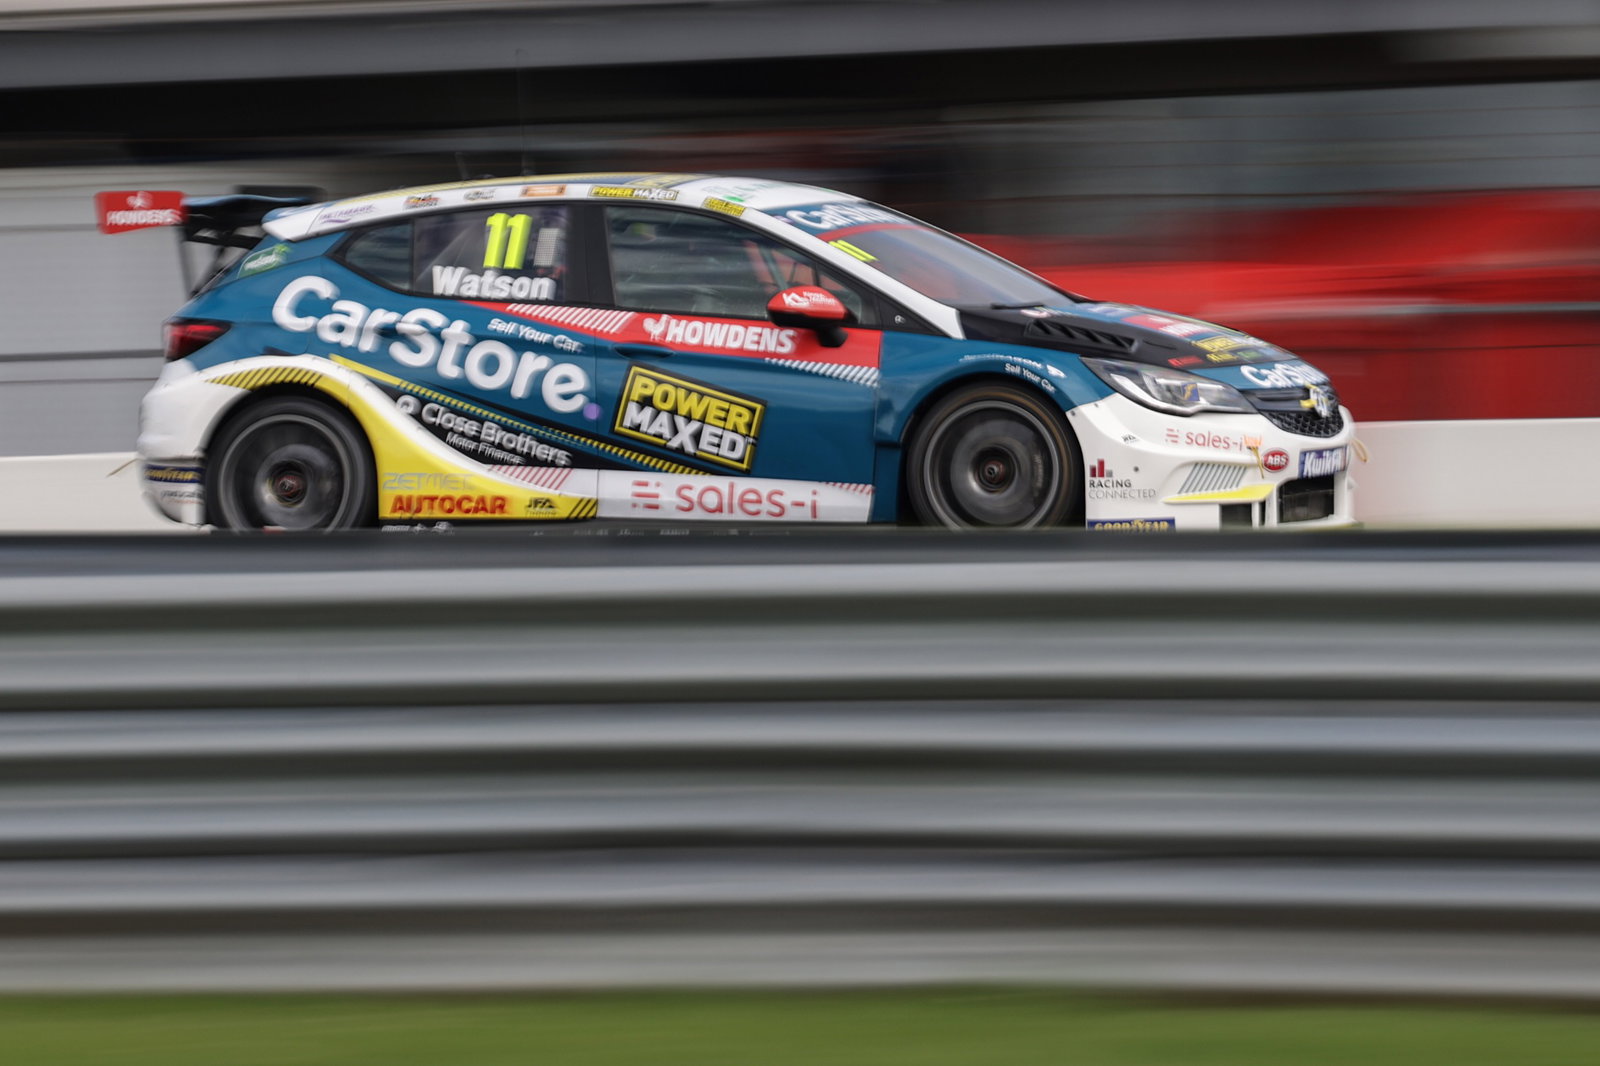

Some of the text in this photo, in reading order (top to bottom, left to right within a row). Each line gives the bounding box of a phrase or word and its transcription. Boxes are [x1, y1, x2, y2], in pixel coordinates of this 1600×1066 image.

[592, 187, 676, 200] POWER MAXED
[482, 213, 533, 270] 11
[432, 265, 558, 300] Watson
[487, 318, 516, 335] Sell
[518, 325, 554, 344] Your
[665, 318, 796, 354] HOWDENS
[1004, 363, 1056, 394] Sell Your Car
[630, 375, 756, 435] POWER
[421, 402, 573, 468] Close Brothers
[445, 431, 527, 466] Motor Finance
[622, 401, 748, 461] MAXED
[1184, 430, 1244, 452] sales-i
[675, 481, 819, 520] sales-i
[1088, 479, 1132, 488] RACING
[1088, 489, 1157, 500] CONNECTED
[390, 495, 508, 515] AUTOCAR
